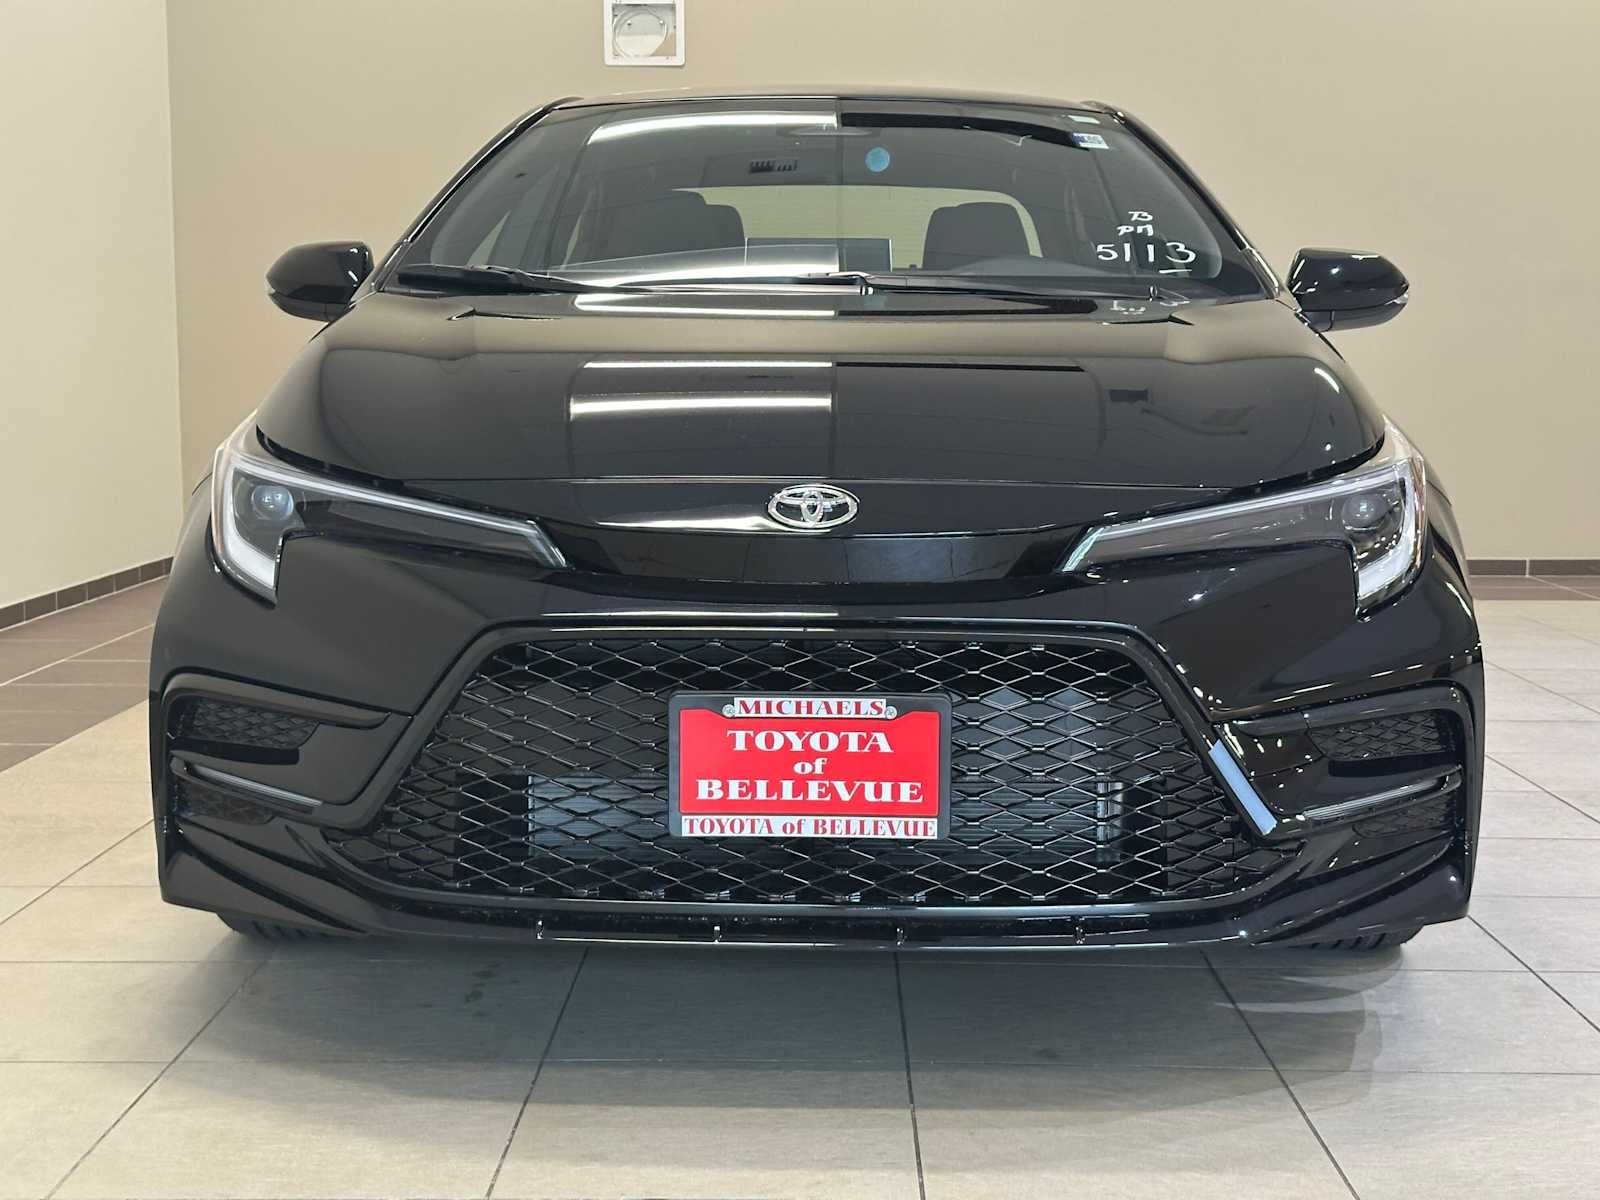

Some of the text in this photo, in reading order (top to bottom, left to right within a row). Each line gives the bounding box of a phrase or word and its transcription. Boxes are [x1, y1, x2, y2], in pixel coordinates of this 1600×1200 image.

[1096, 241, 1196, 263] 5113
[738, 700, 884, 716] MICHAELS
[727, 730, 894, 752] TOYOTA
[793, 758, 827, 774] of
[696, 779, 923, 803] BELLEVUE
[684, 817, 936, 837] TOYOTA of BELLEVUE
